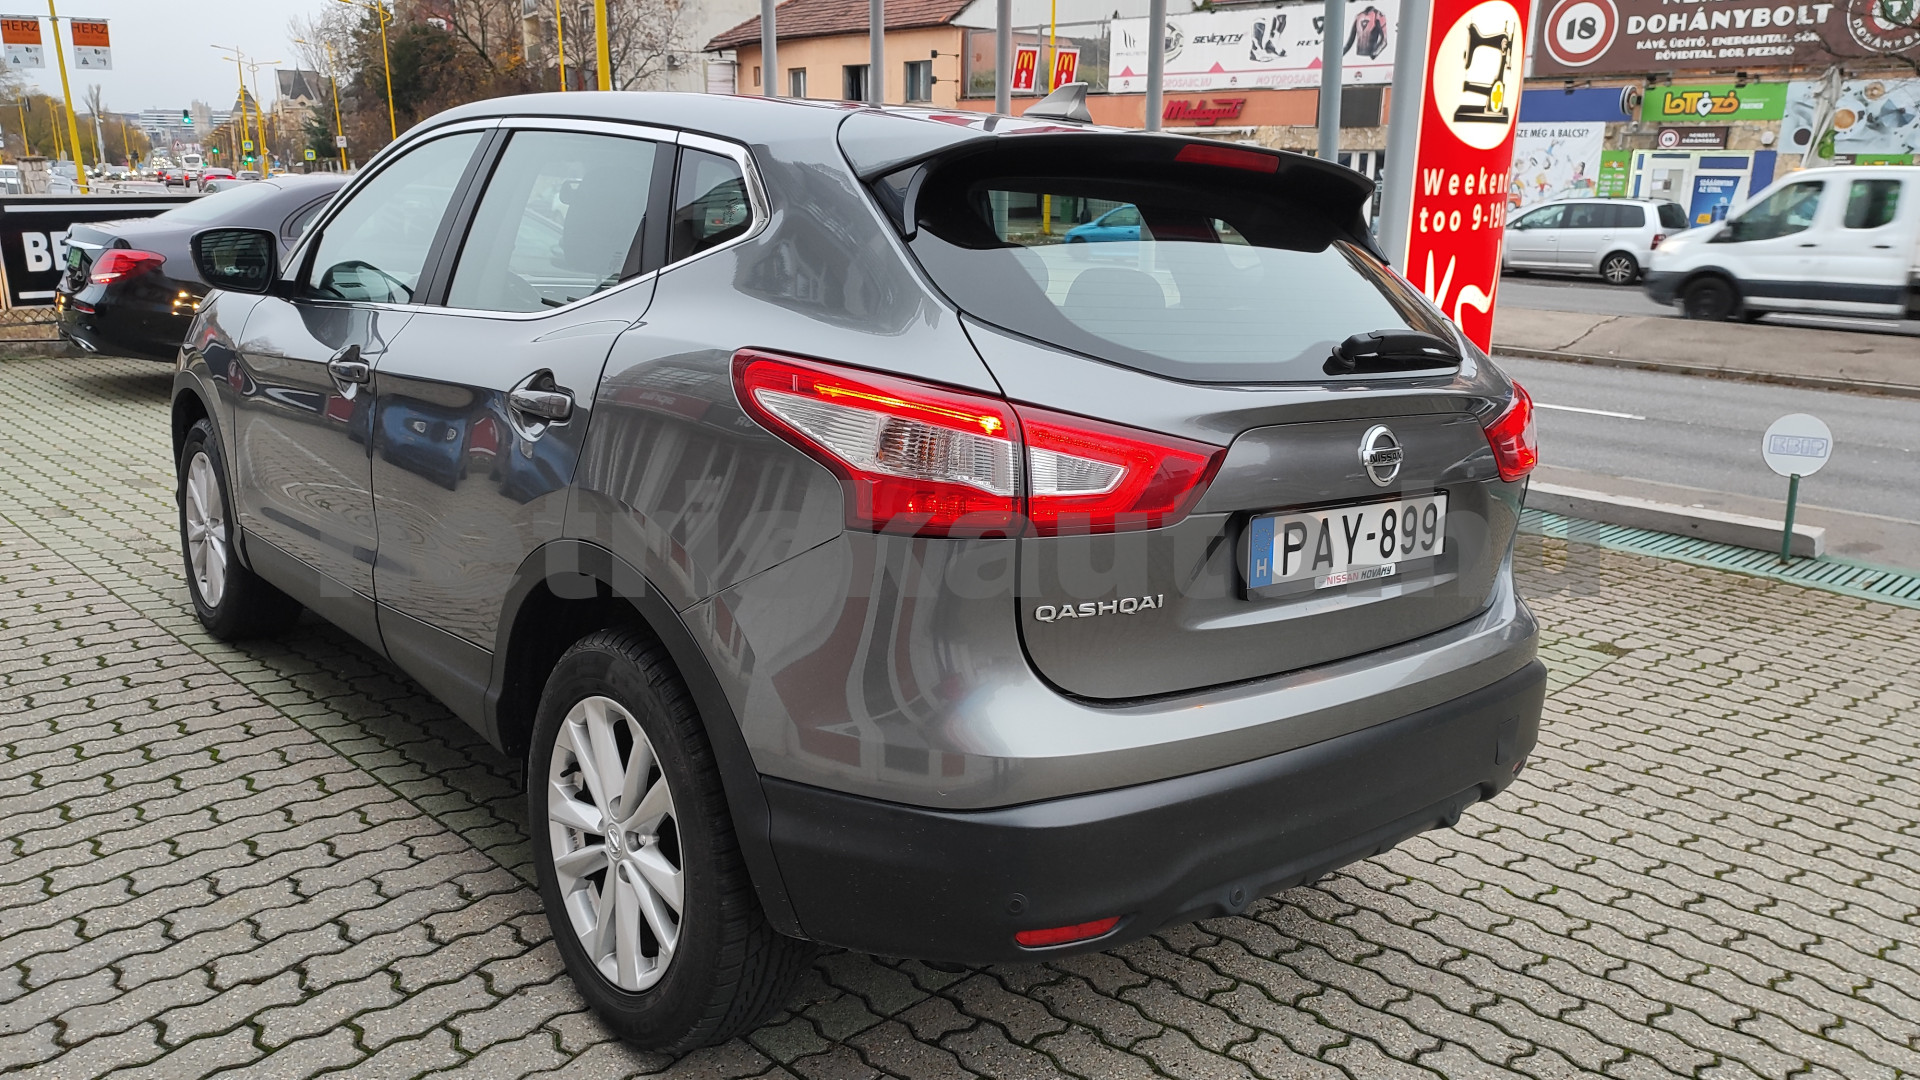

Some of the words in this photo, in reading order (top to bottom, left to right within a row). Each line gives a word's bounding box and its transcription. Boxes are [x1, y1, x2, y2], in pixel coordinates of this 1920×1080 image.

[1566, 17, 1596, 40] 18
[1627, 4, 1834, 34] DOHÁNYBOLT
[1192, 33, 1244, 46] SEVENTY
[1530, 127, 1547, 138] MÉG
[1550, 129, 1555, 138] A
[1423, 166, 1510, 196] Weekend
[1419, 207, 1461, 232] too
[1369, 452, 1402, 463] NISSAN
[1256, 558, 1268, 578] H
[1282, 503, 1438, 575] PAY-899
[1326, 572, 1359, 586] NISSAN
[1035, 594, 1164, 623] QASHQAI
